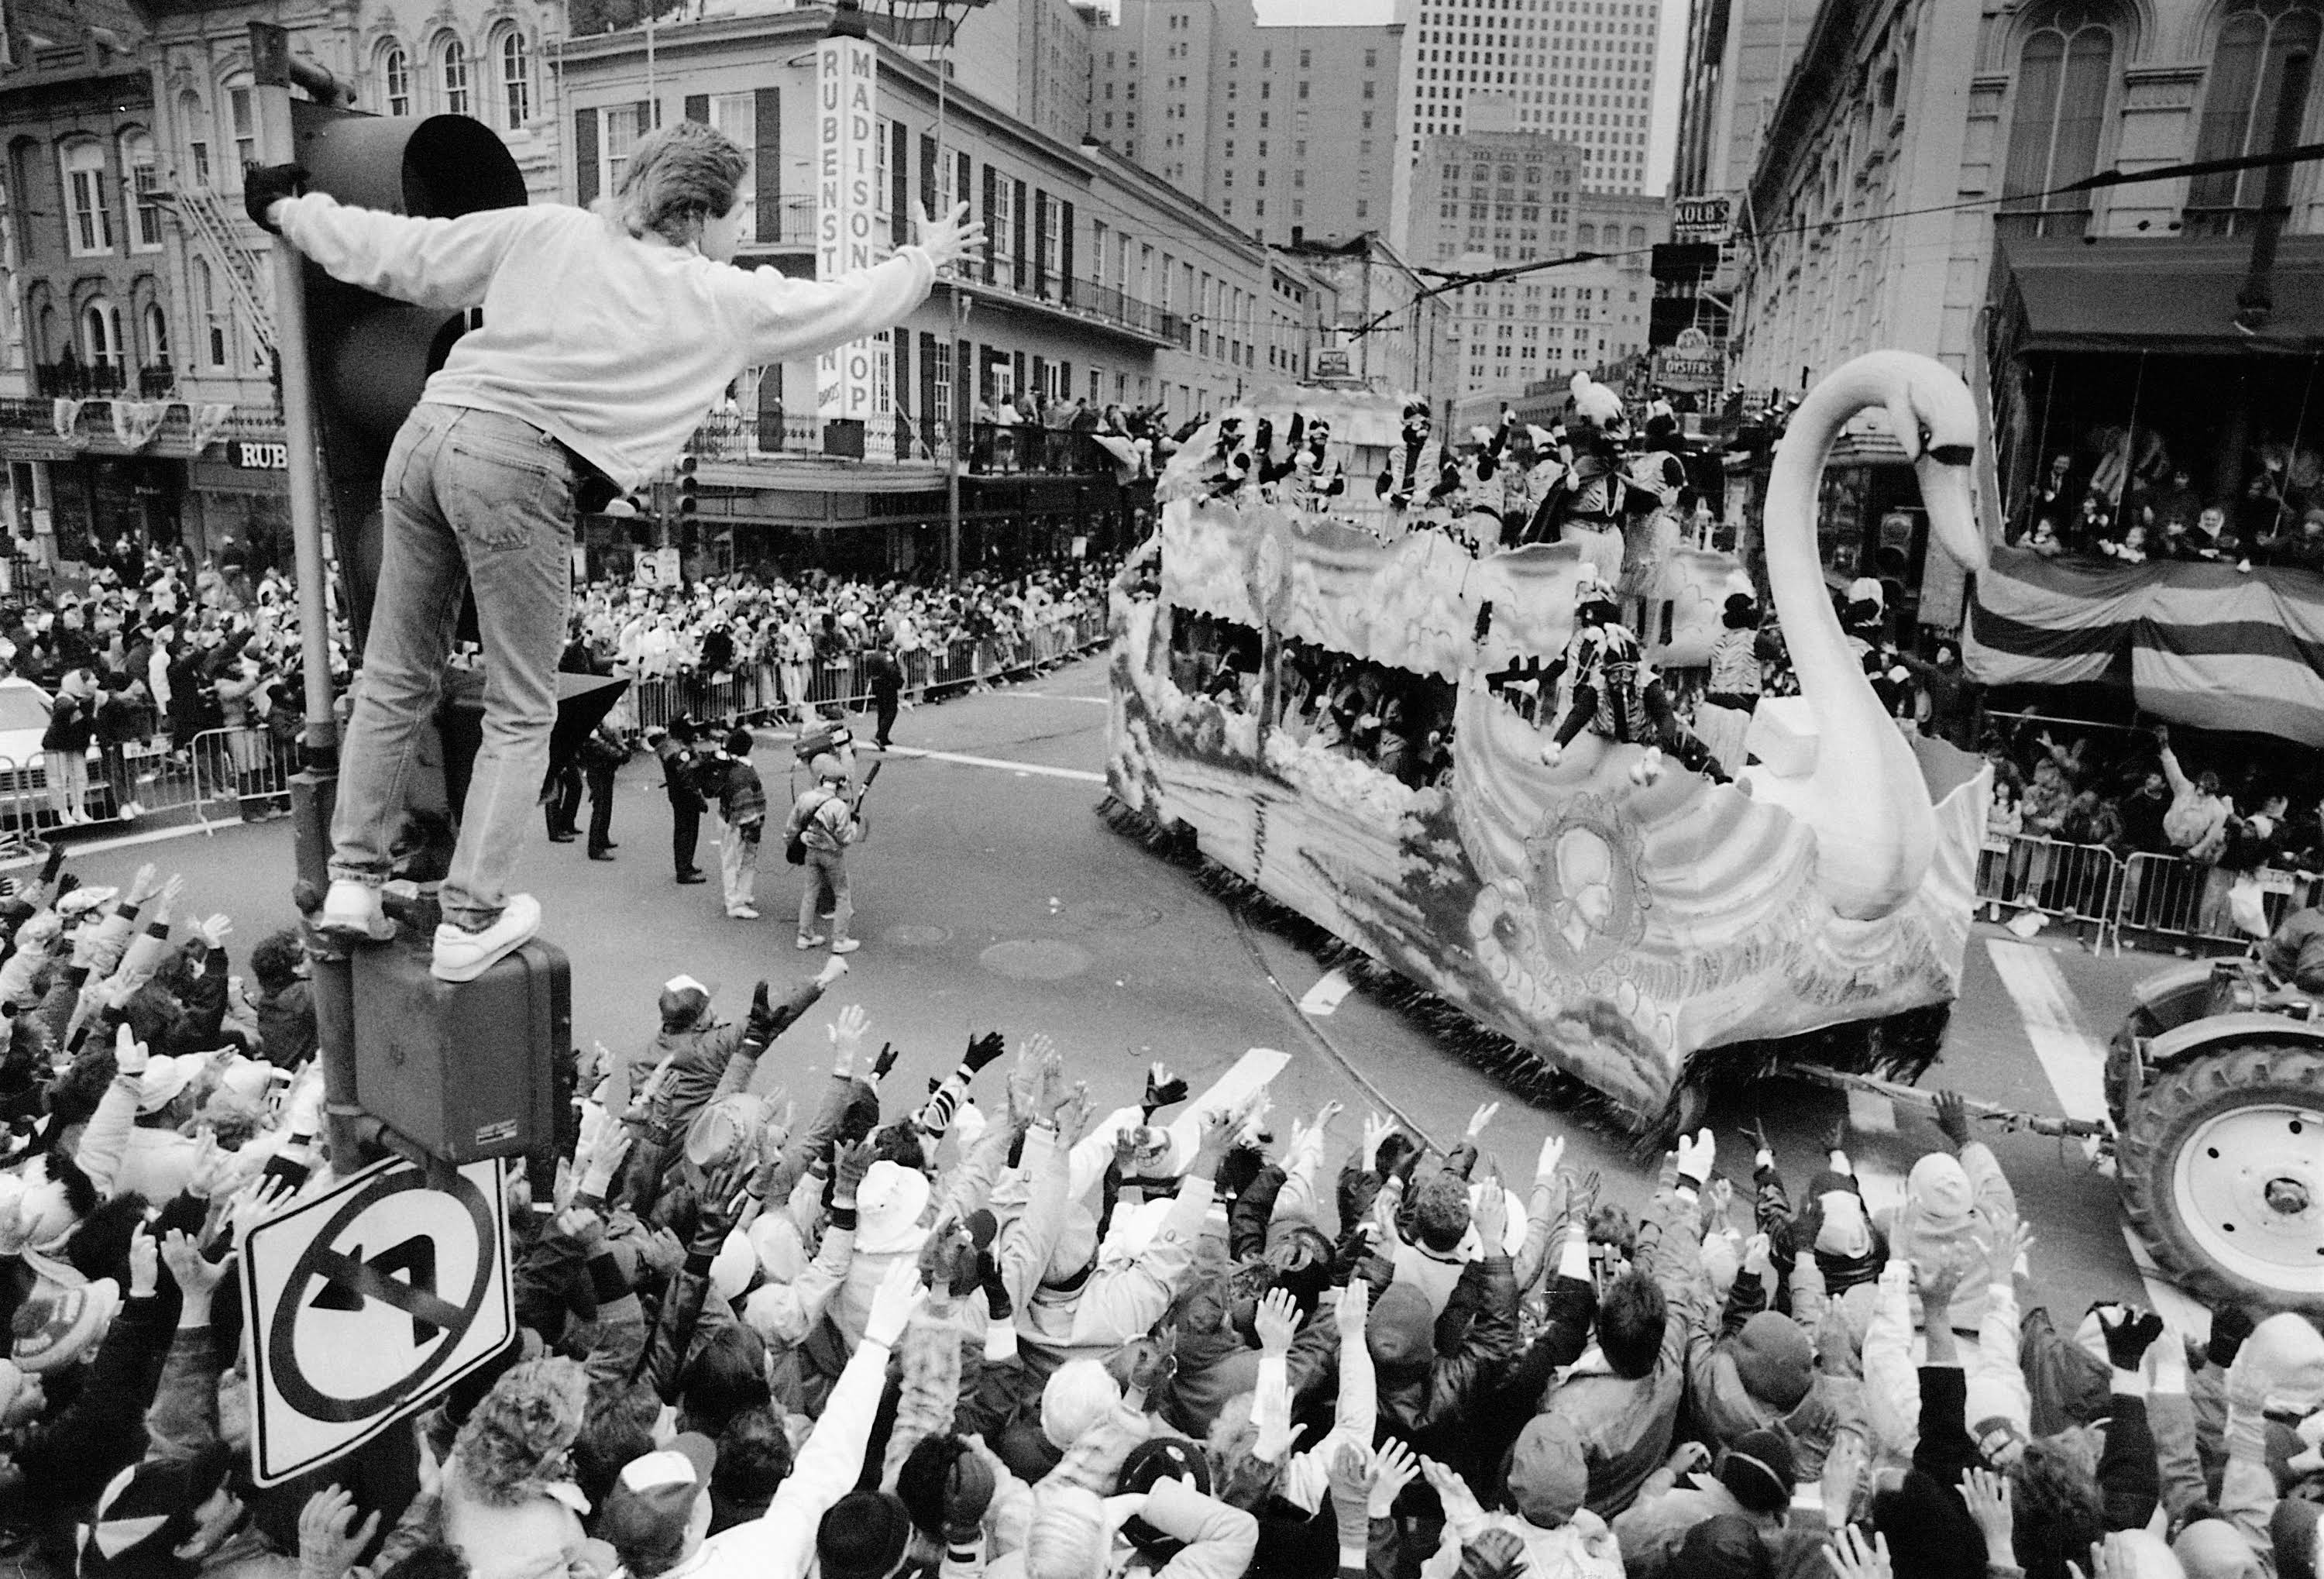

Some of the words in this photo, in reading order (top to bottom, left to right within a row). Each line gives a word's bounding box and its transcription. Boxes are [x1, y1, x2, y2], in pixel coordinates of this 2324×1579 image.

[822, 50, 838, 370] RUBENSTN
[851, 49, 870, 270] MADISON
[1675, 203, 1728, 222] KOLB'S
